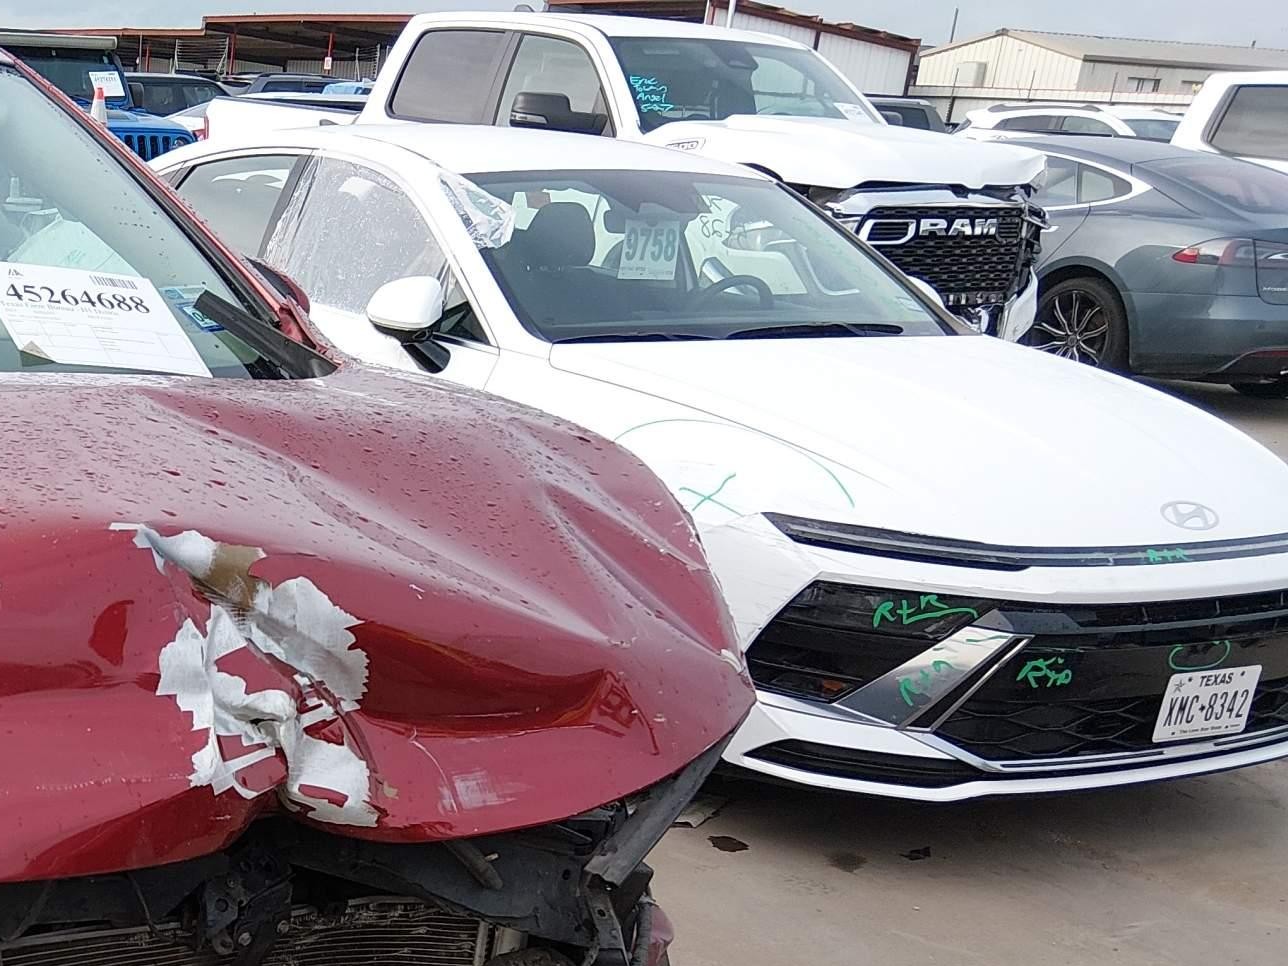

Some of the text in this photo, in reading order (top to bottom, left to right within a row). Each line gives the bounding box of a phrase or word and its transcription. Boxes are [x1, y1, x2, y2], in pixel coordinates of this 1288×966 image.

[919, 218, 999, 236] RAM
[625, 227, 677, 262] 9758
[6, 283, 151, 314] 45264688
[1199, 672, 1234, 687] TEXAS
